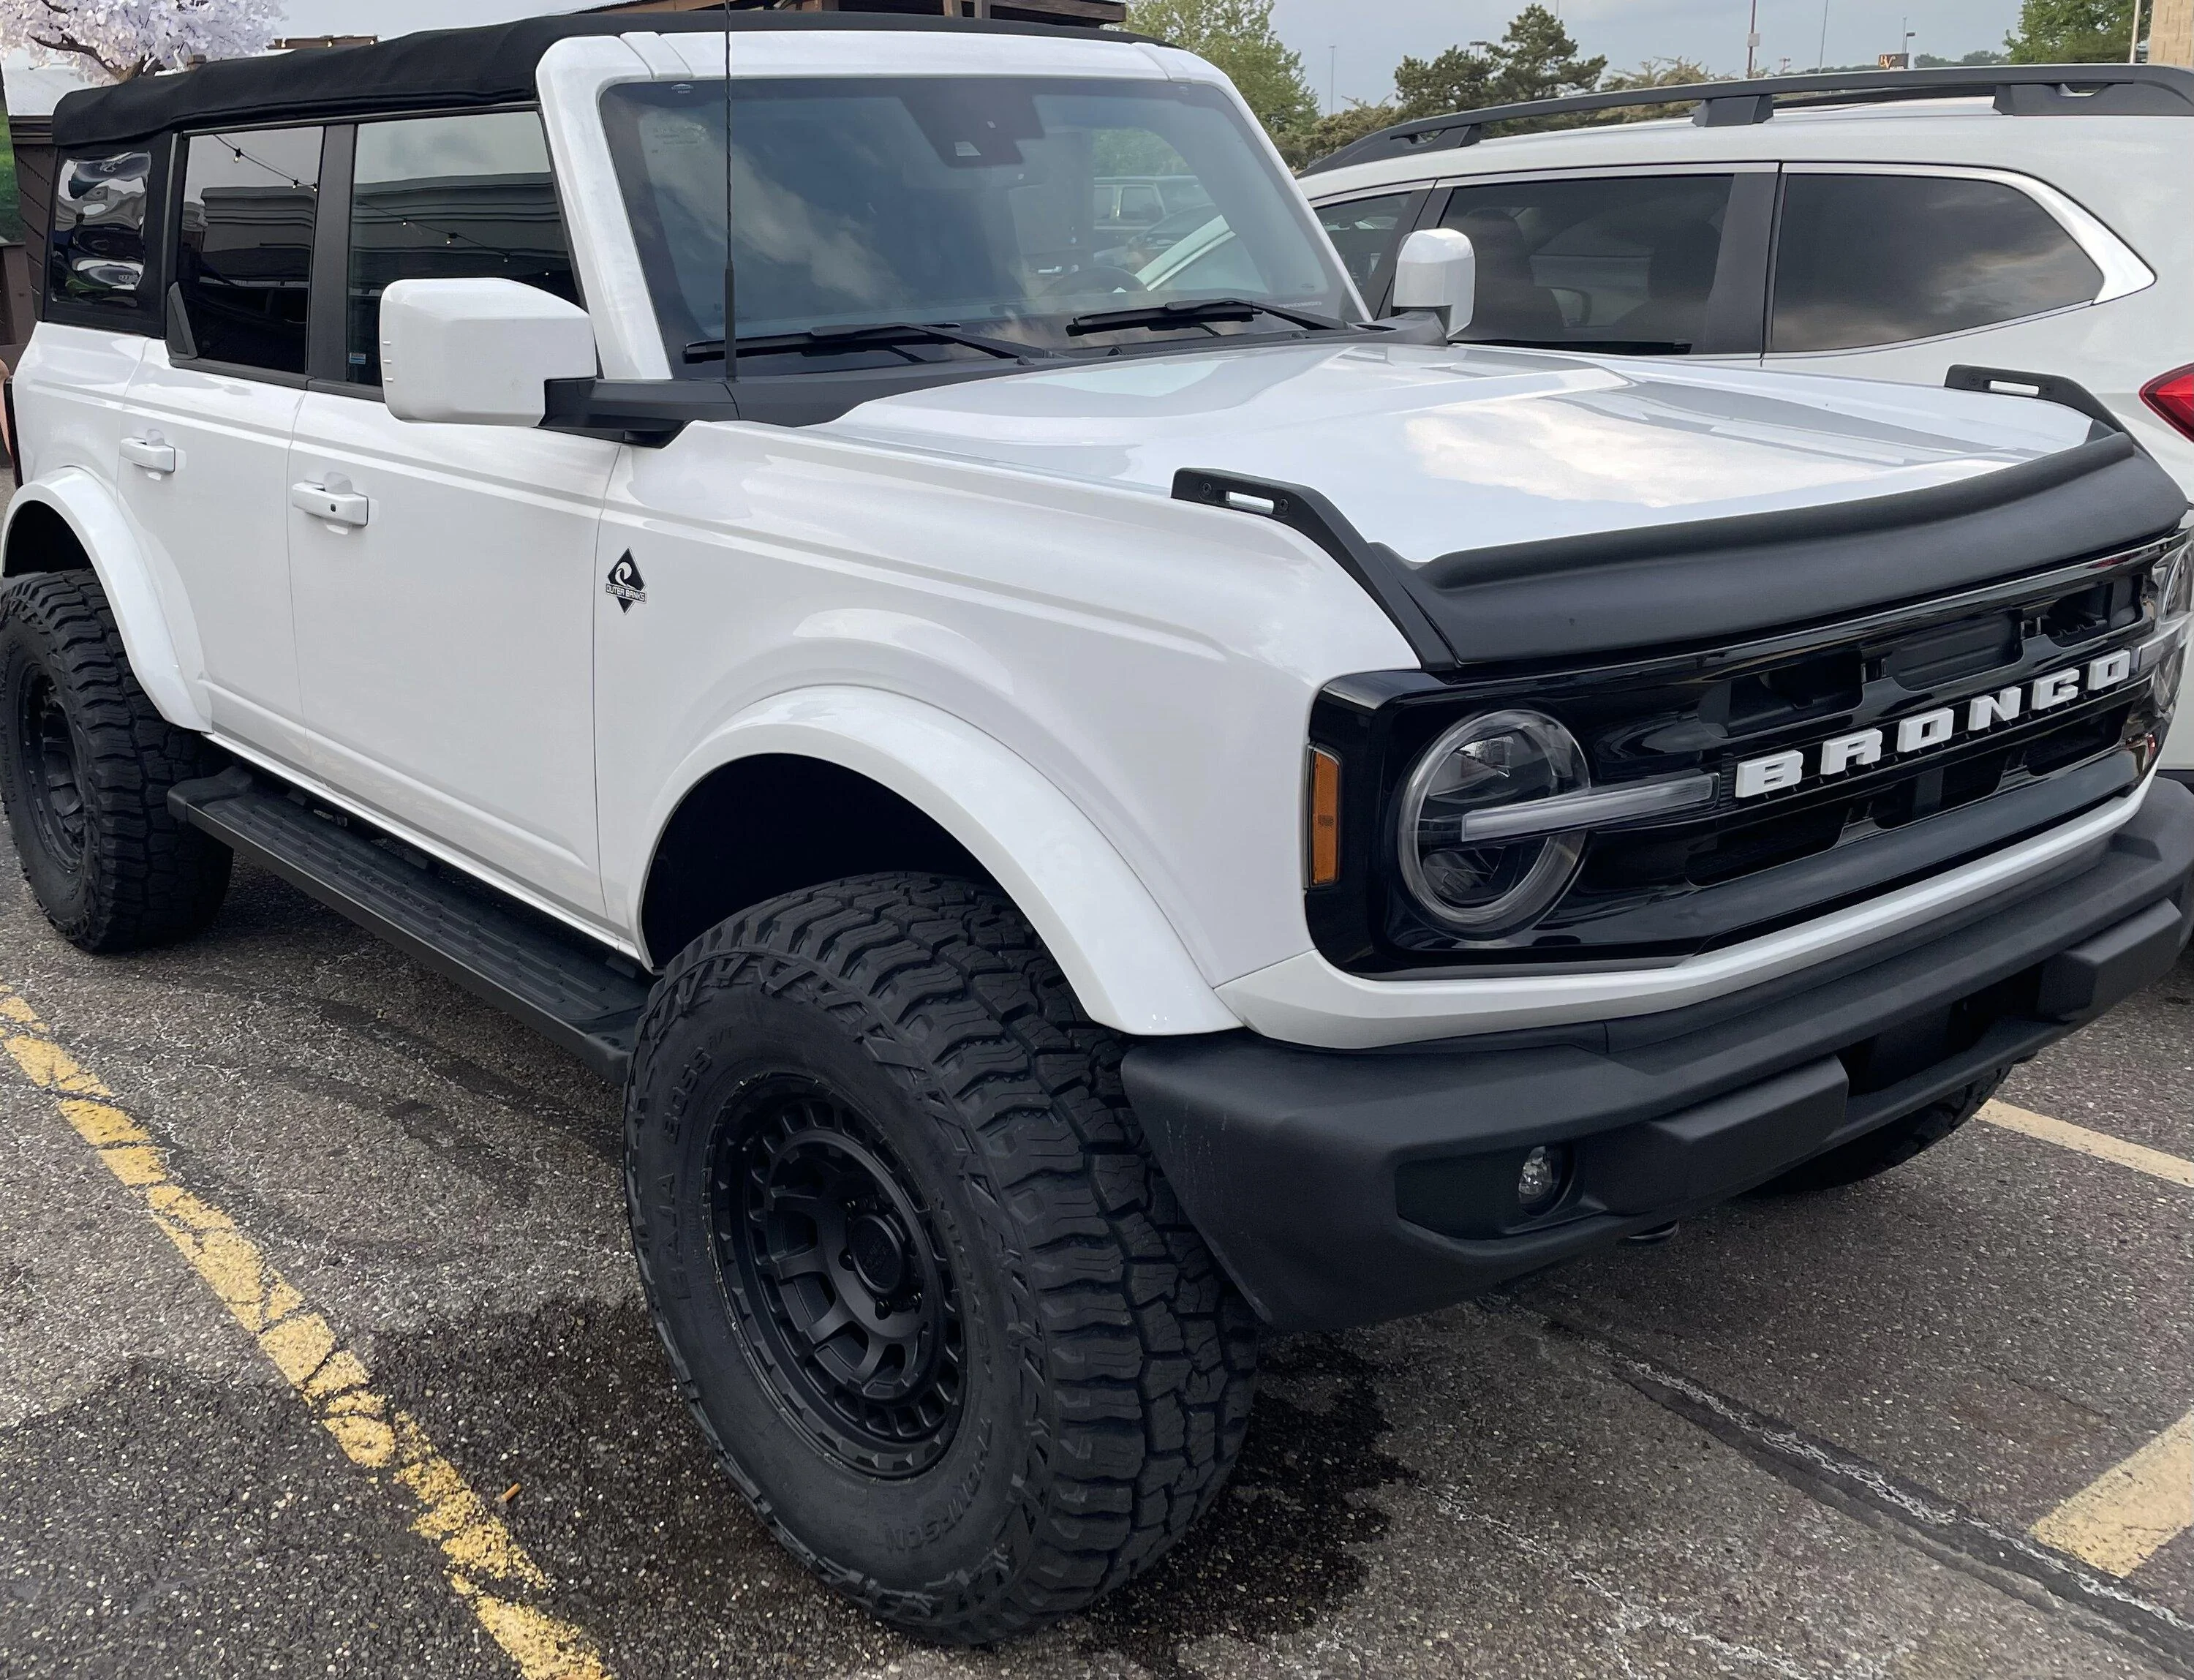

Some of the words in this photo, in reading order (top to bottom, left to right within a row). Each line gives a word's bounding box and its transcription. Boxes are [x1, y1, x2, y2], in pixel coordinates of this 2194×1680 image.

[606, 585, 625, 595] OUTER
[626, 589, 645, 600] BANKS
[1735, 649, 2130, 798] BRONCO
[663, 1047, 712, 1145] BOSS
[886, 1416, 993, 1551] THOMPSON
